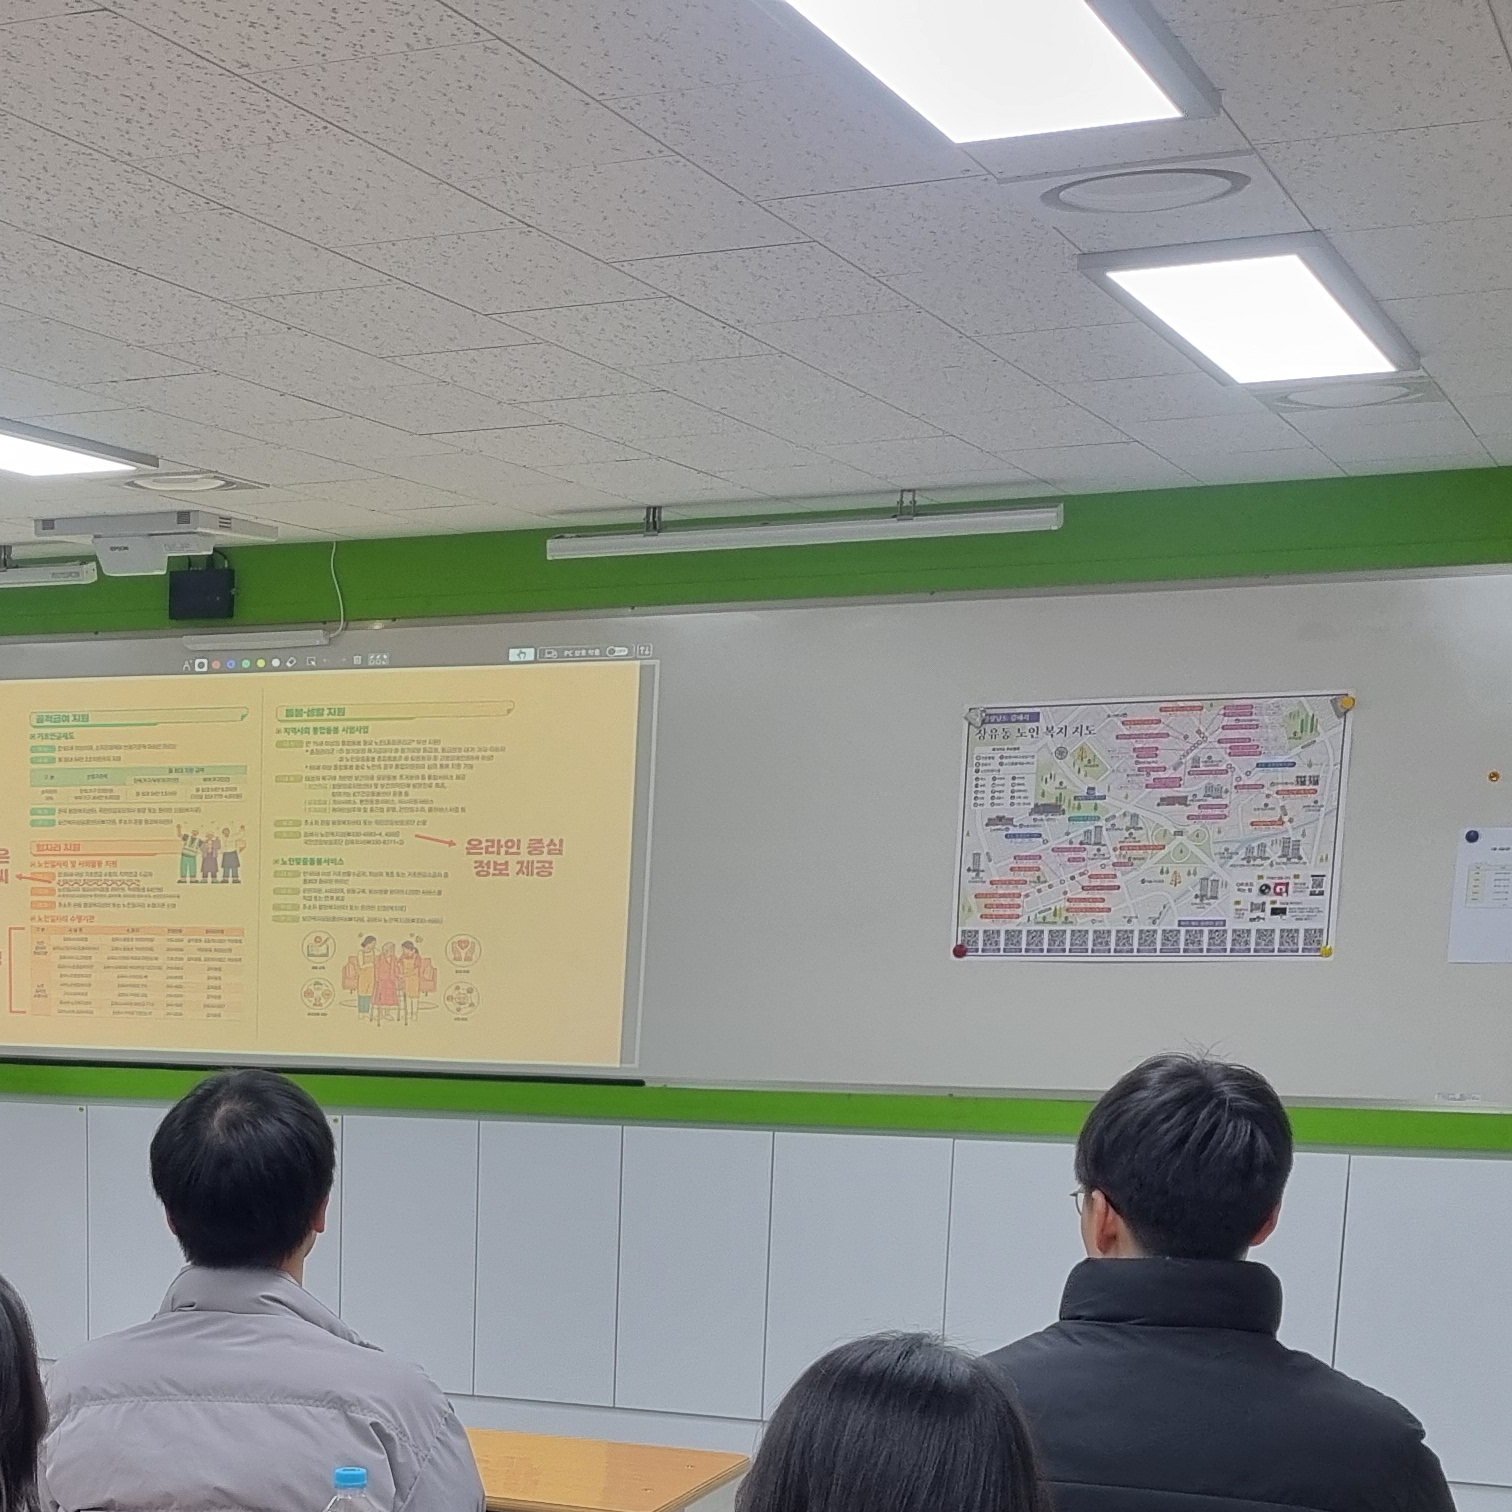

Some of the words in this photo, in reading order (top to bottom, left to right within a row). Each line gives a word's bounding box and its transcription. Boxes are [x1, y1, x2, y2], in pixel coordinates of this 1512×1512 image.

[1016, 725, 1040, 739] 노인
[1072, 723, 1097, 738] 지도
[465, 838, 522, 856] 온라인
[526, 838, 565, 856] 중심
[474, 860, 510, 878] 정보
[516, 860, 555, 878] 제공
